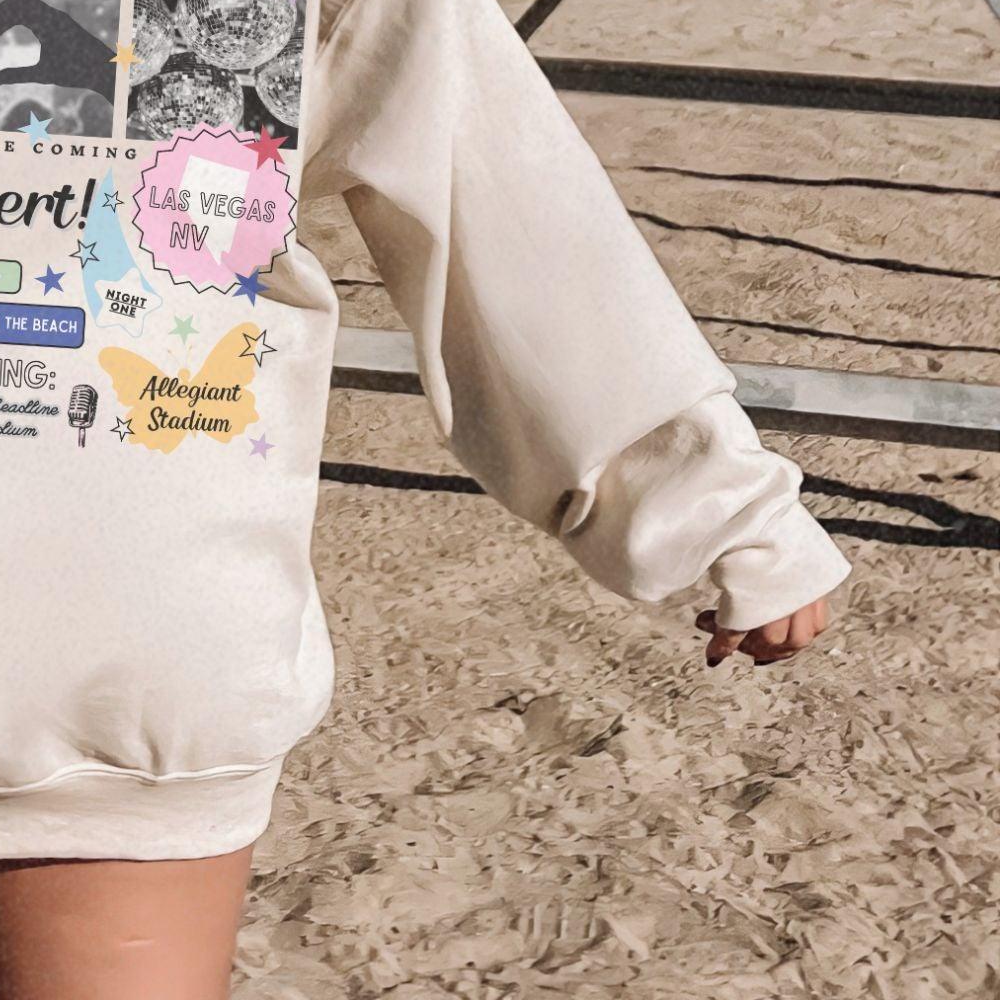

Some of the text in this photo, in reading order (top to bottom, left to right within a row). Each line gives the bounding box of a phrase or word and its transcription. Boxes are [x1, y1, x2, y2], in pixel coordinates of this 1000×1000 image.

[33, 142, 138, 161] COMING
[149, 185, 276, 223] LAS VEGAS
[169, 222, 210, 251] NV
[105, 288, 148, 308] NIGHT
[110, 302, 137, 318] ONE
[5, 316, 28, 331] THE
[32, 318, 78, 334] BEACH
[139, 375, 242, 407] Allegiant
[147, 406, 233, 433] Stadium
